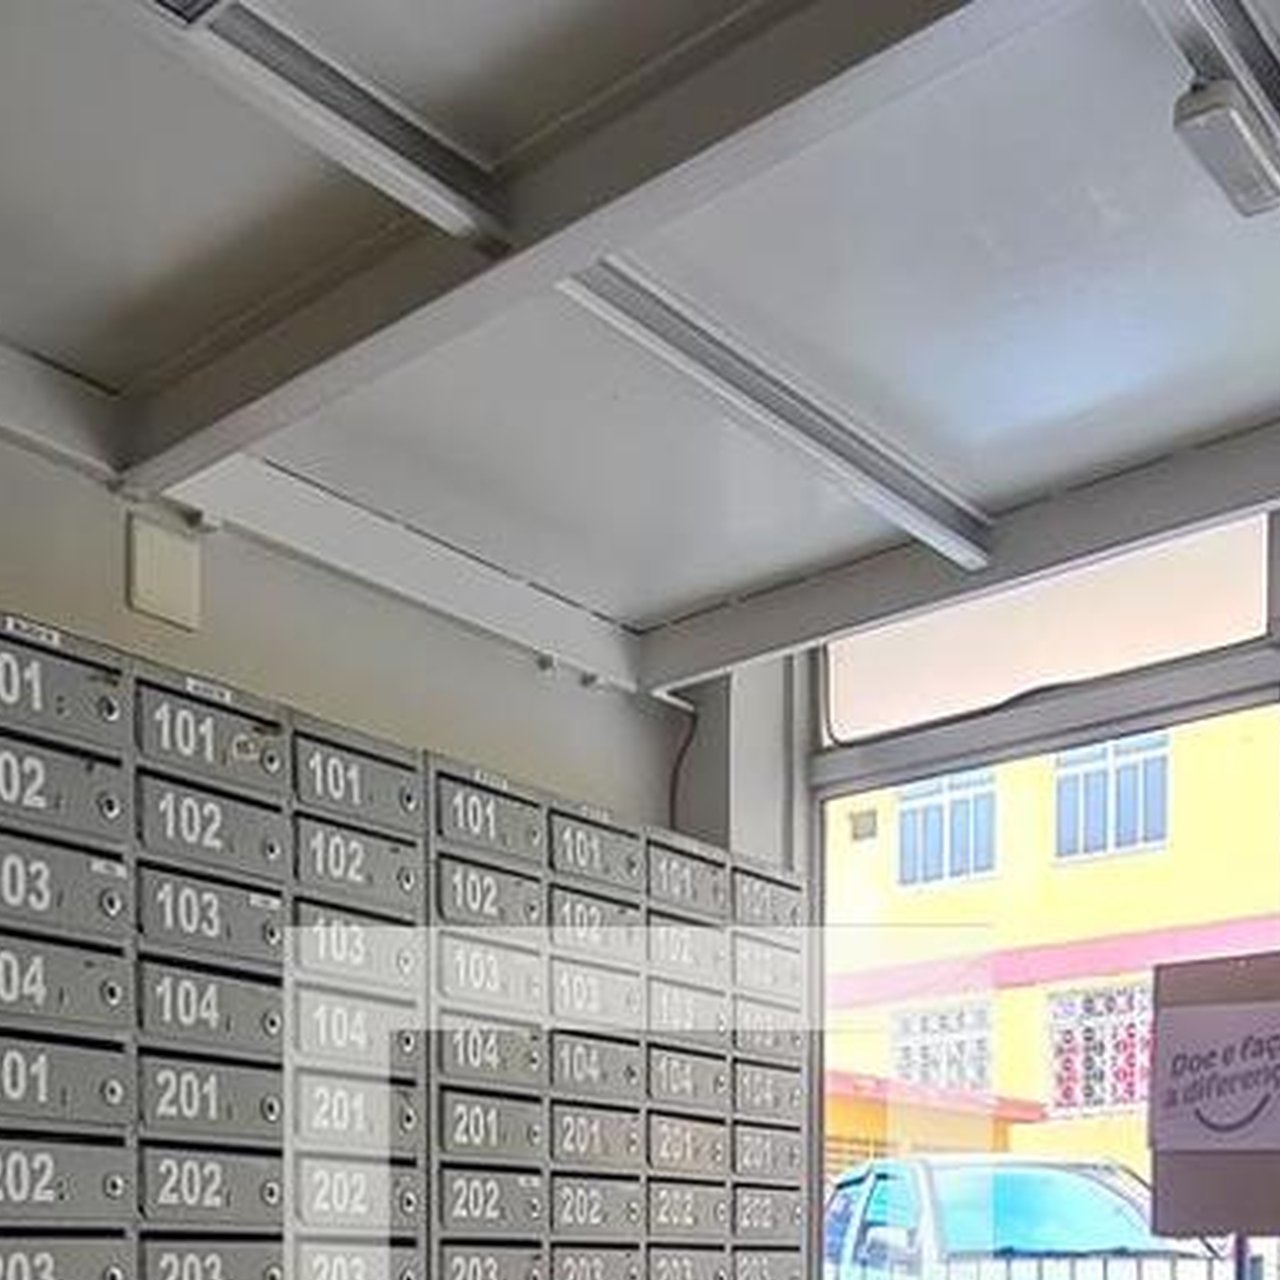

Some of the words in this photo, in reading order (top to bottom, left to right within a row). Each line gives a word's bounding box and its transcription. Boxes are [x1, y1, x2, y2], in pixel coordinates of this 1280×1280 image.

[154, 702, 213, 762] 101
[309, 751, 360, 805] 101
[159, 792, 222, 849] 102
[452, 792, 495, 840] 101
[311, 831, 364, 882] 102
[157, 883, 220, 937] 103
[453, 867, 498, 915] 102
[156, 976, 219, 1028] 104
[452, 1027, 499, 1069] 104
[1172, 1049, 1217, 1077] Doe
[1222, 1047, 1236, 1067] e
[157, 1069, 217, 1119] 201
[312, 1087, 366, 1131] 201
[1164, 1089, 1178, 1107] a
[452, 1104, 498, 1147] 201
[158, 1159, 222, 1207] 202
[313, 1170, 367, 1214] 202
[452, 1178, 500, 1219] 202
